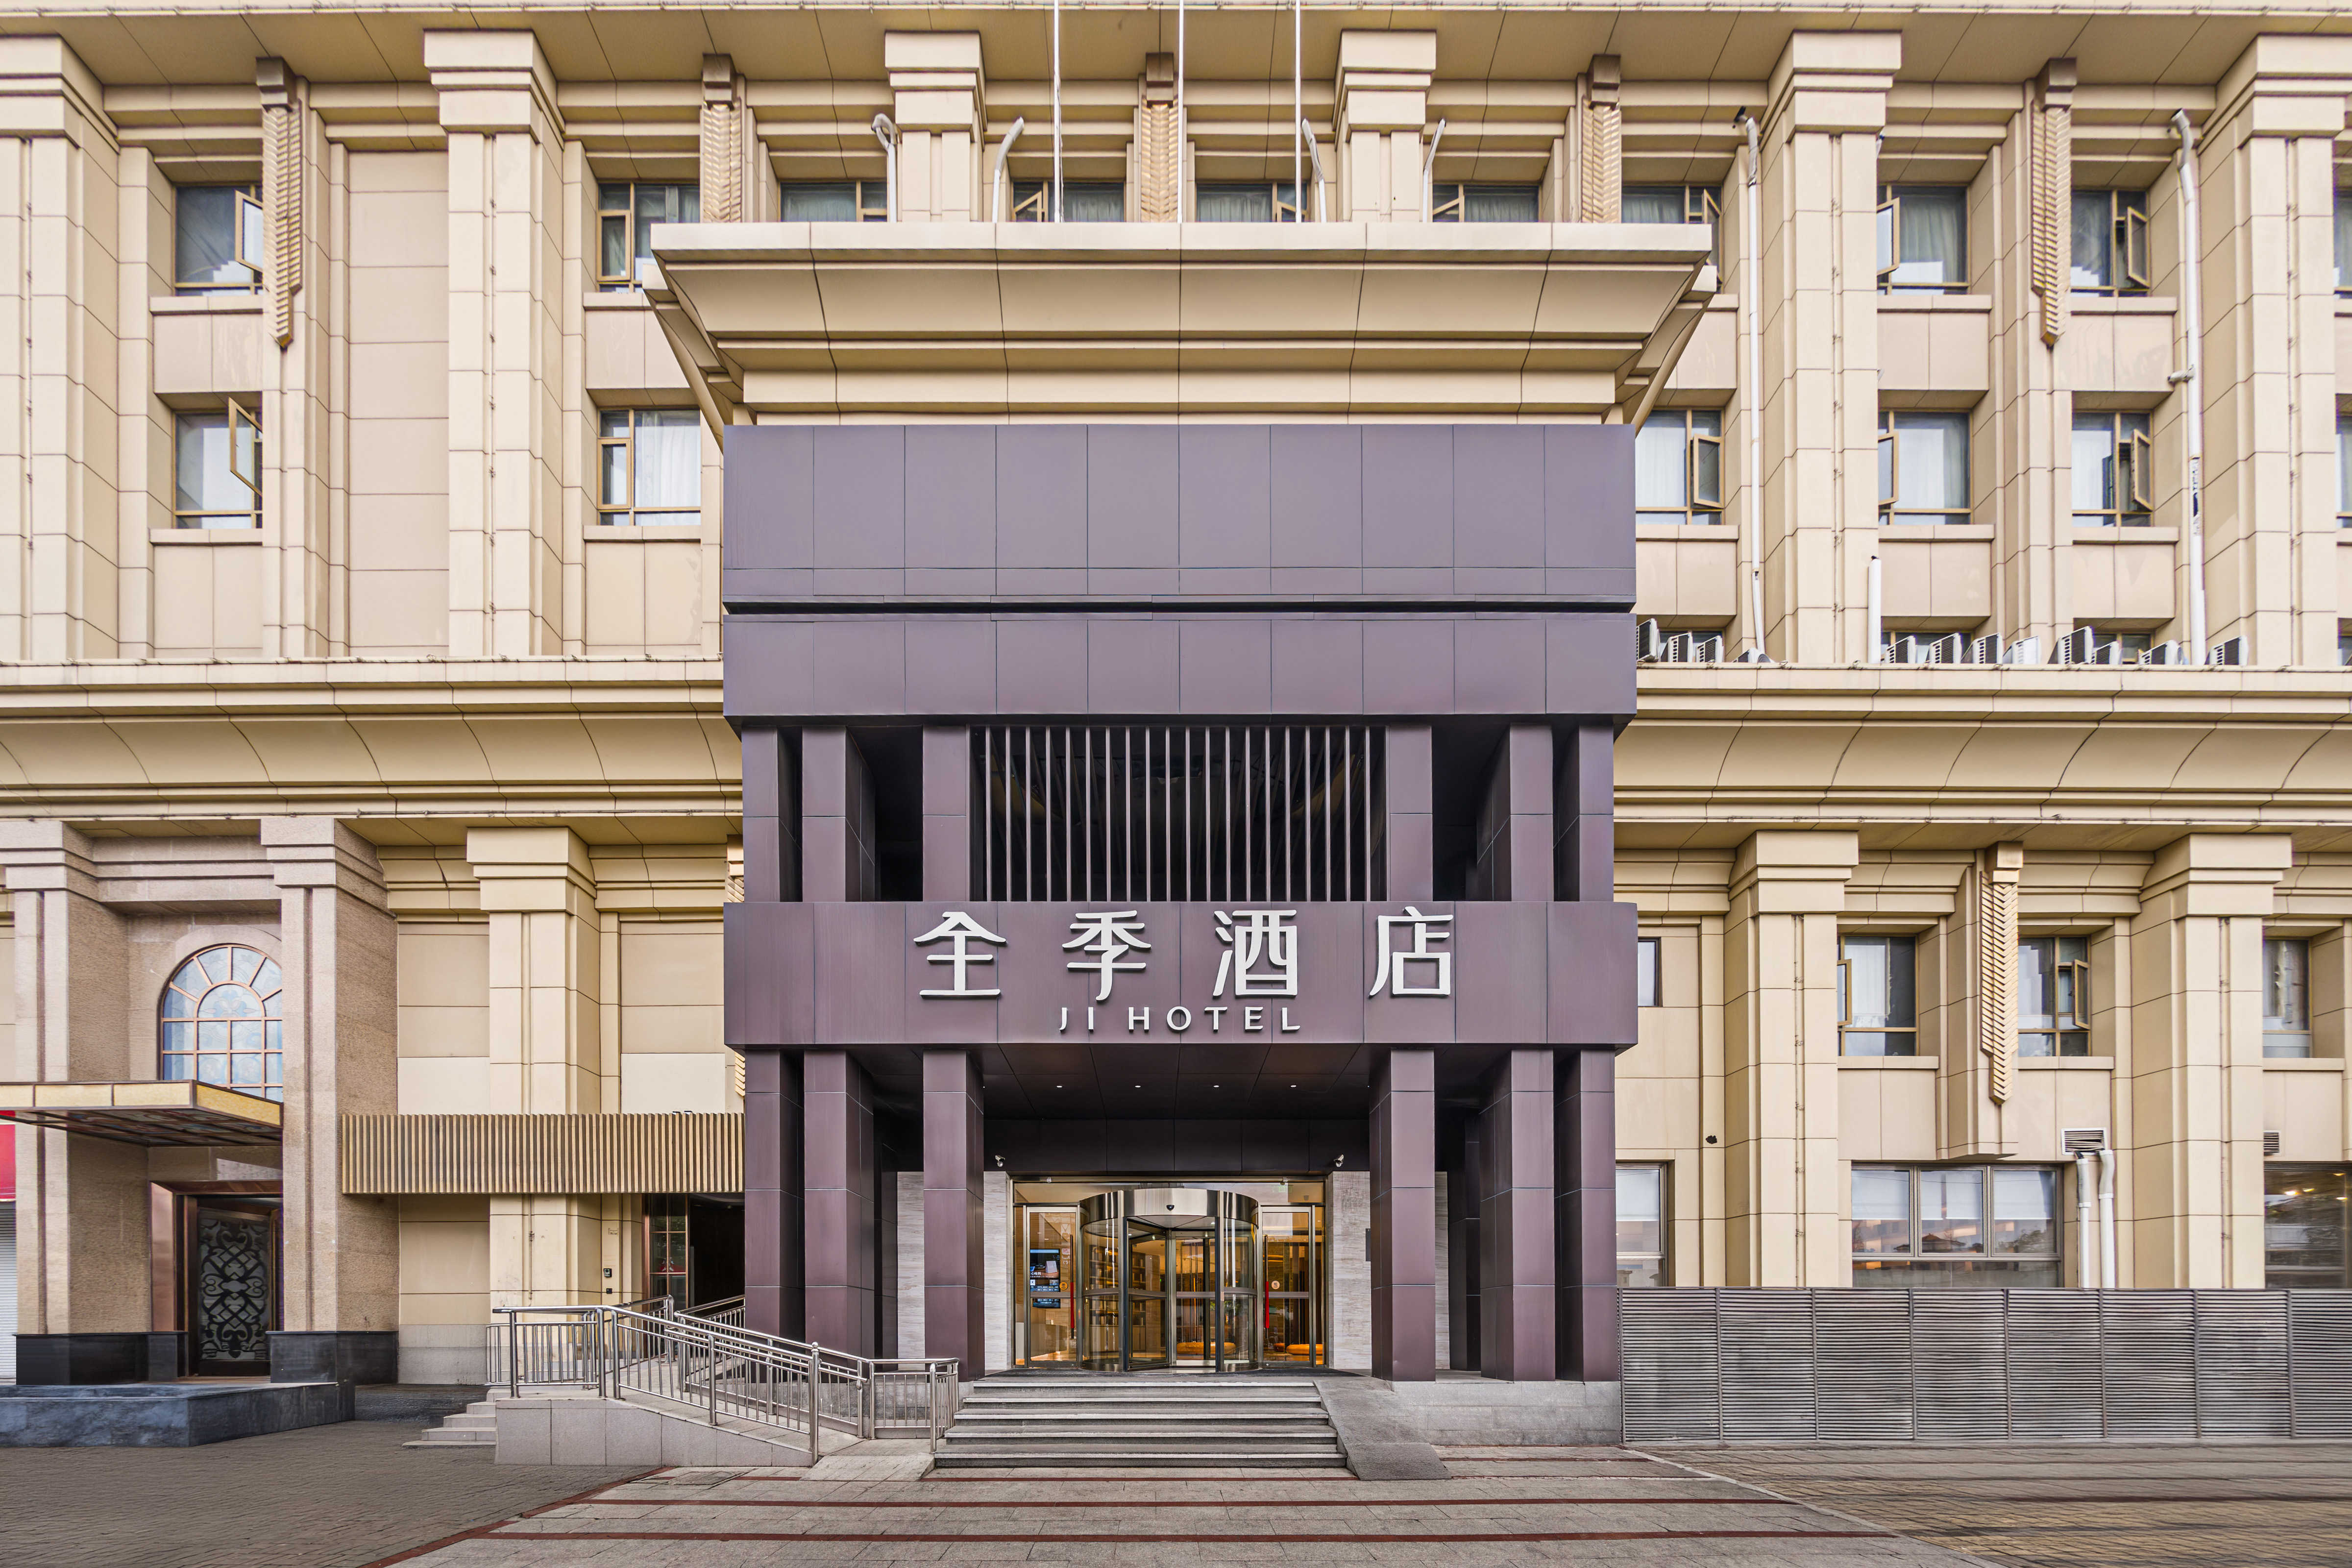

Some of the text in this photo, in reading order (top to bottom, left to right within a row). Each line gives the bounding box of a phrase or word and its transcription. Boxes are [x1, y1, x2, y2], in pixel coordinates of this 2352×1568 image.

[913, 906, 1454, 1001] 全季酒店
[1059, 1006, 1301, 1030] JI HOTEL
